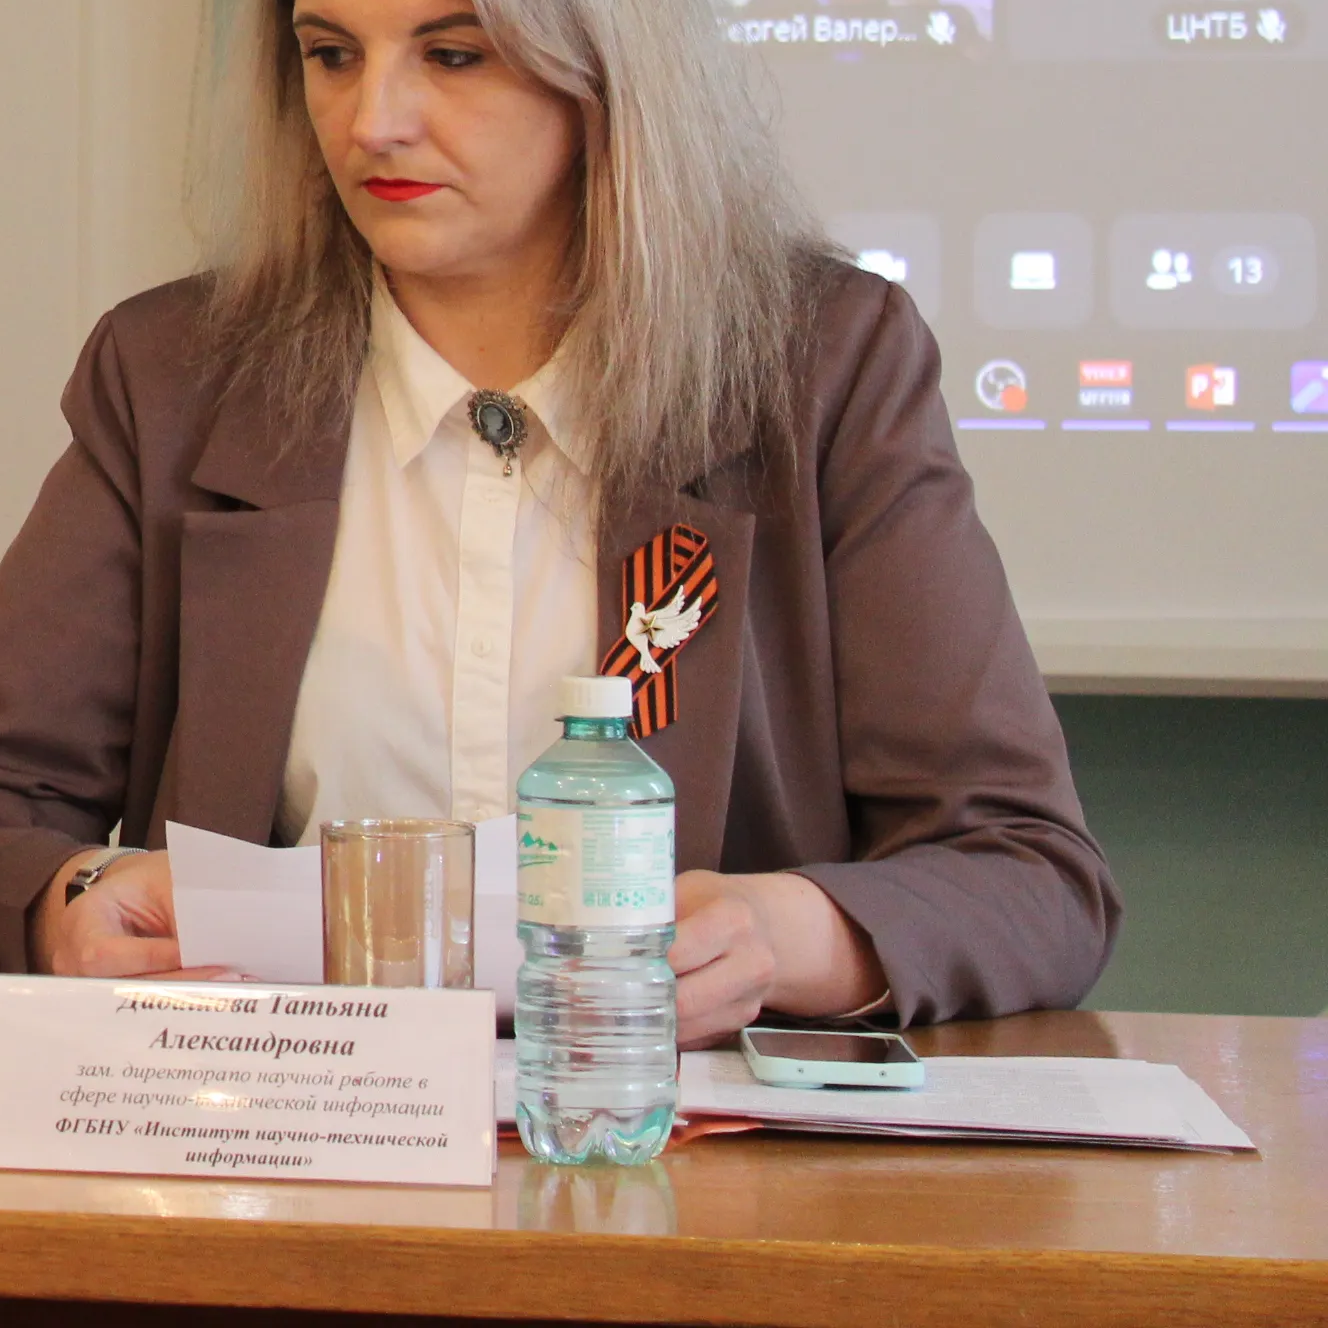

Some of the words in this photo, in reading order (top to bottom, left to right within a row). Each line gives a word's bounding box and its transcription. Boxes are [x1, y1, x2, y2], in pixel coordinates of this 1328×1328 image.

[723, 14, 808, 44] ергей
[1167, 14, 1248, 43] ЦНТБ
[1229, 257, 1263, 283] 13
[269, 992, 388, 1020] Татьяна
[149, 1027, 356, 1059] Александровна
[75, 1065, 114, 1078] зам.
[257, 1069, 334, 1088] научной
[339, 1071, 412, 1091] работе
[418, 1077, 429, 1089] в
[59, 1085, 116, 1106] сфере
[323, 1095, 444, 1119] информации
[55, 1118, 129, 1136] ФГБНУ
[134, 1121, 249, 1145] «Институт
[255, 1129, 448, 1149] научно-технической
[185, 1147, 312, 1169] информации»
